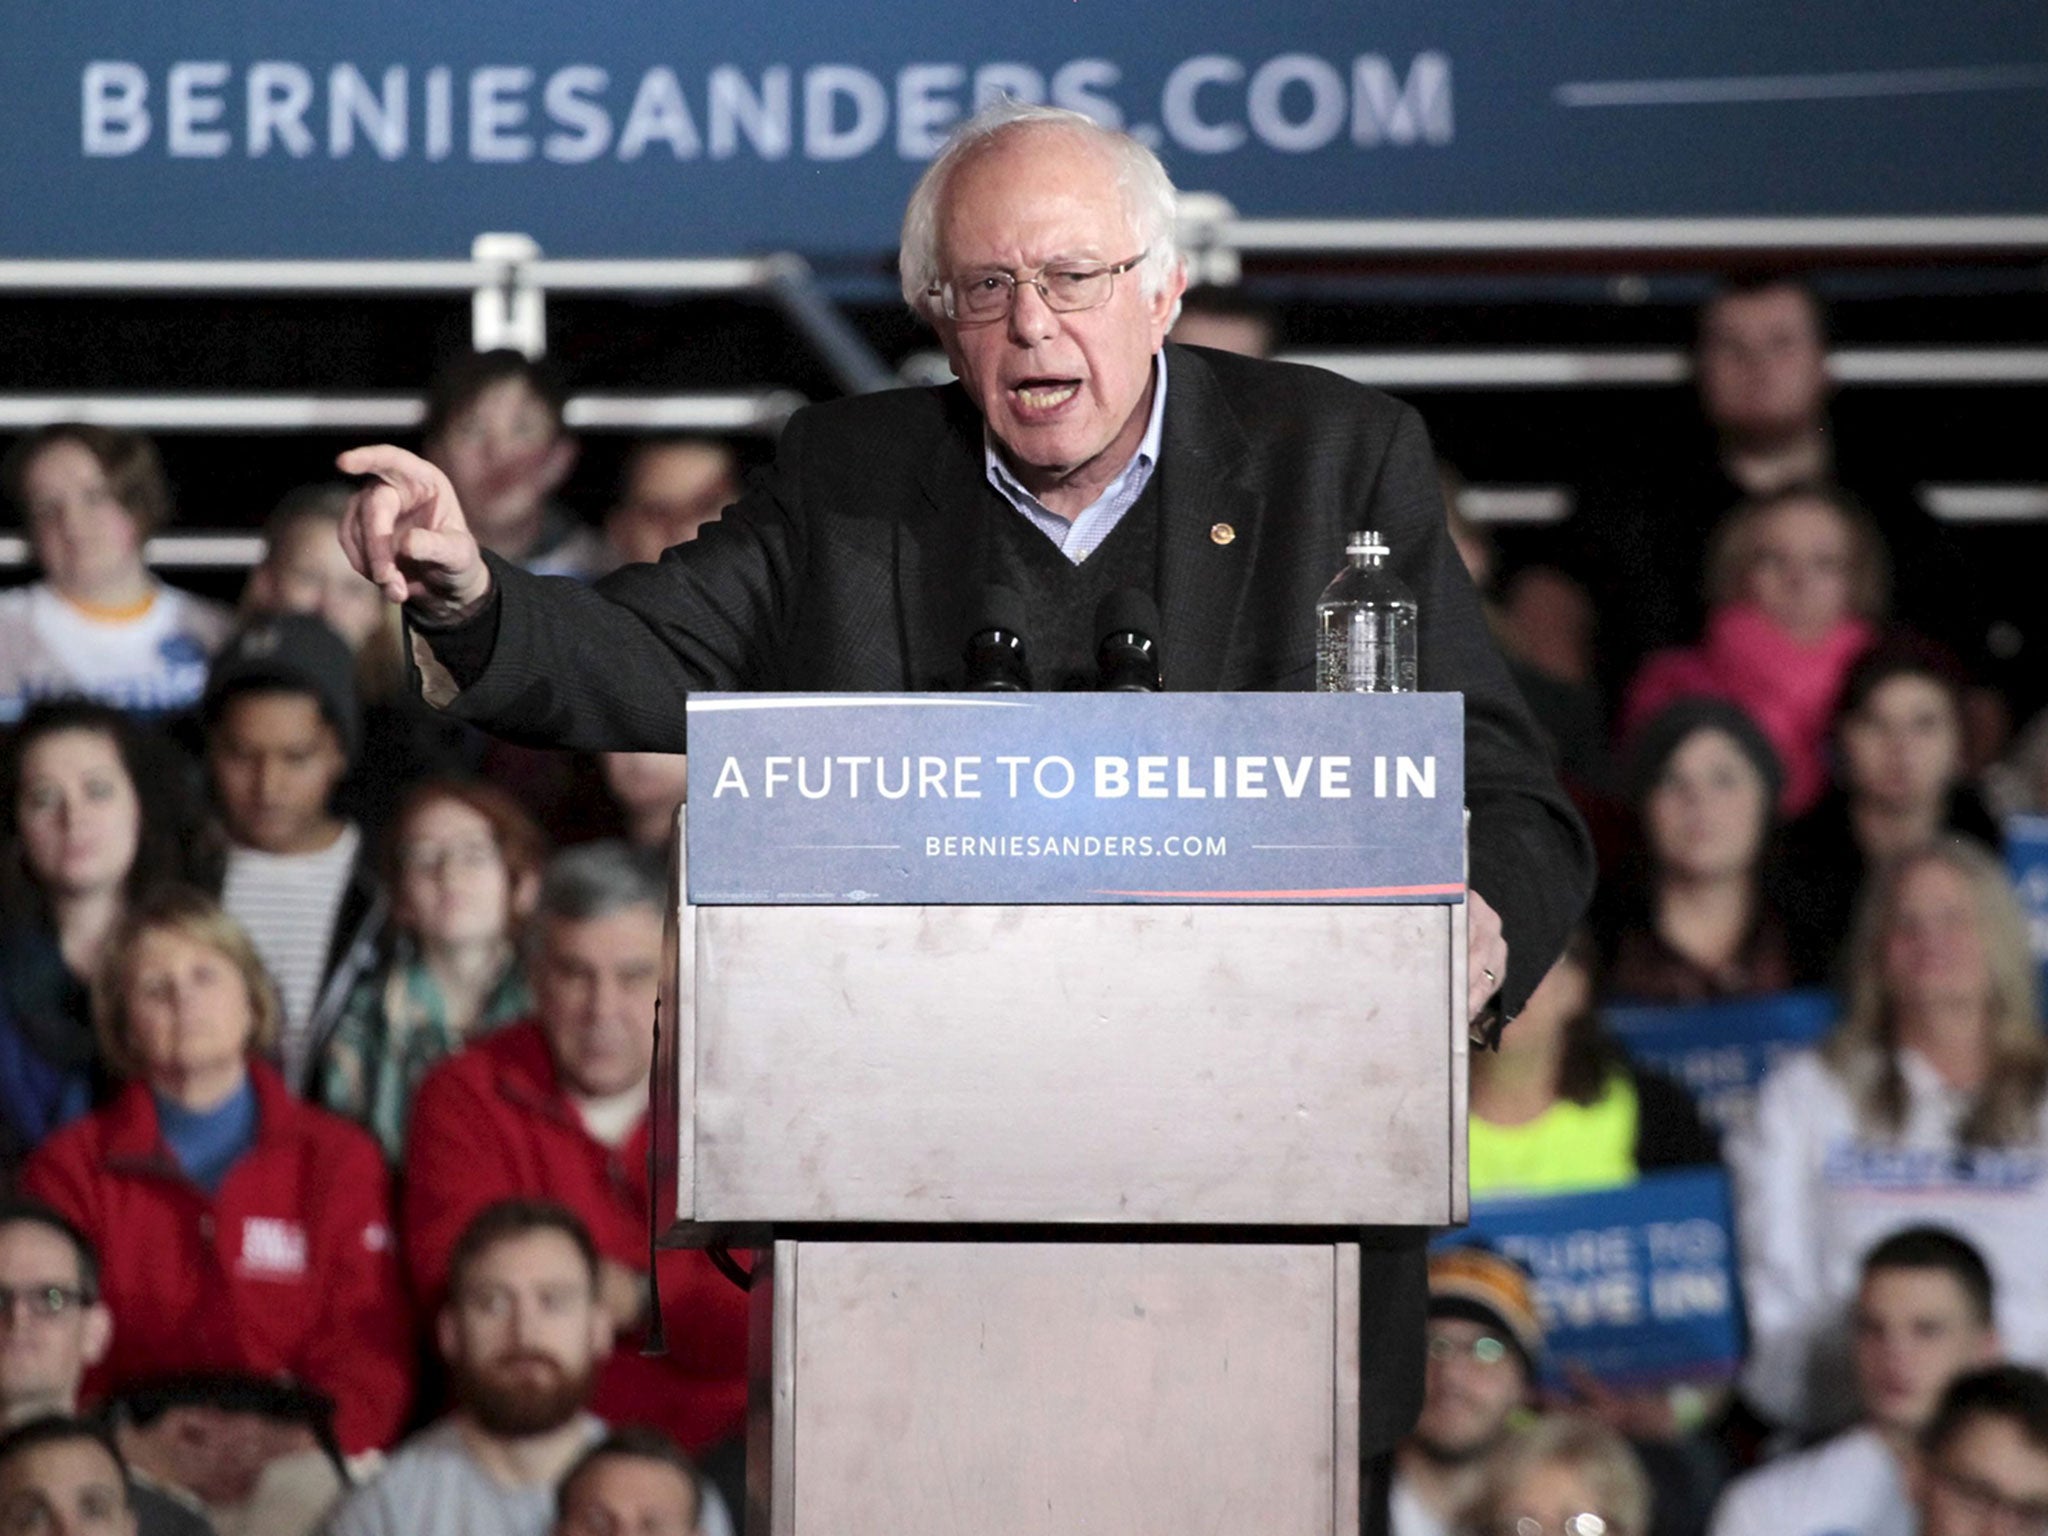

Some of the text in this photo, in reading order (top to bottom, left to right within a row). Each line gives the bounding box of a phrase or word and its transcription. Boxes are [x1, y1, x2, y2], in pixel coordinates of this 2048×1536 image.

[712, 755, 1436, 799] A FUTURE TO BELIEVE IN
[925, 835, 1227, 857] BERNIESANDERS.COM
